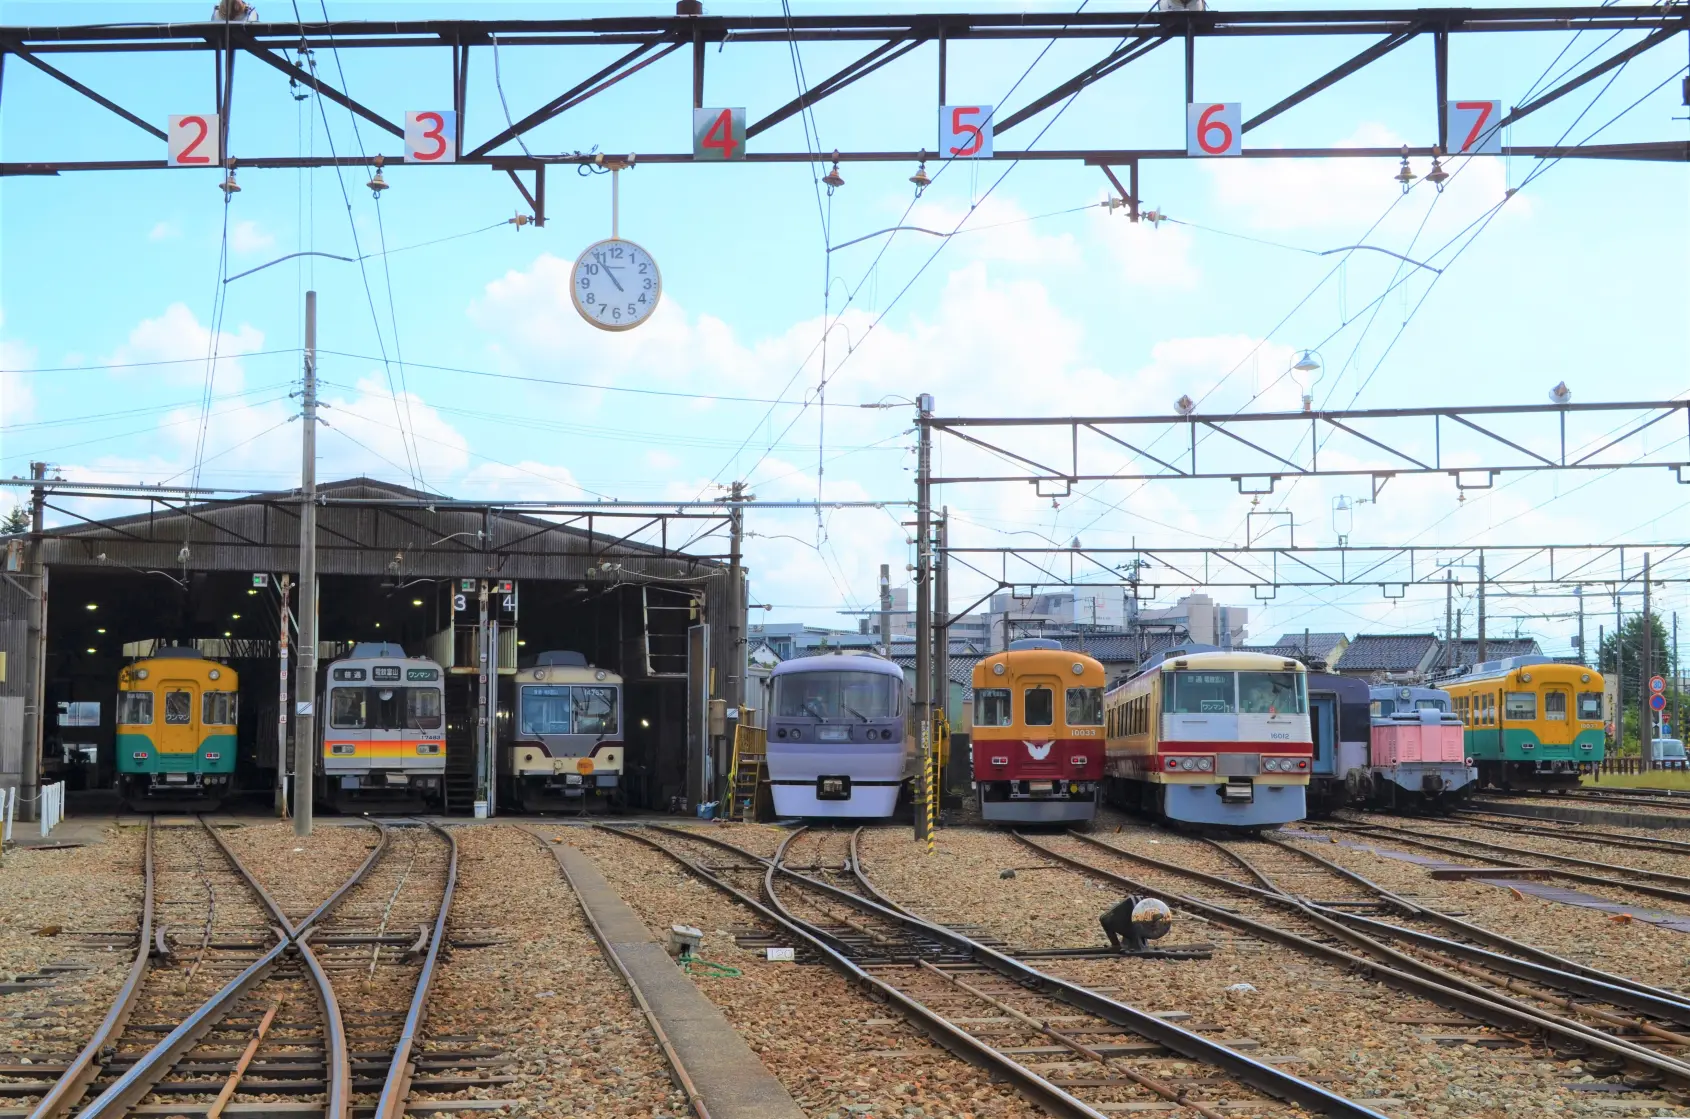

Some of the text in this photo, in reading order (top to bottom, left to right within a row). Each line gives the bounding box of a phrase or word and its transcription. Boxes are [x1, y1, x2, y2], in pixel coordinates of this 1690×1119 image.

[950, 107, 983, 156] 5
[1197, 104, 1233, 155] 6
[1456, 102, 1493, 152] 7
[413, 112, 447, 161] 3
[702, 108, 739, 159] 4
[176, 116, 210, 164] 2
[594, 251, 607, 264] 11
[608, 247, 624, 259] 12
[629, 253, 635, 264] 1
[584, 263, 599, 275] 10
[638, 263, 648, 274] 2
[581, 277, 590, 289] 9
[643, 278, 652, 290] 3
[586, 292, 595, 304] 8
[638, 293, 647, 304] 4
[598, 304, 607, 314] 7
[612, 307, 621, 319] 6
[628, 303, 636, 315] 5
[454, 594, 466, 611] 3
[503, 594, 516, 611] 4
[167, 713, 190, 721] ワンマン
[1270, 732, 1290, 740] 16012
